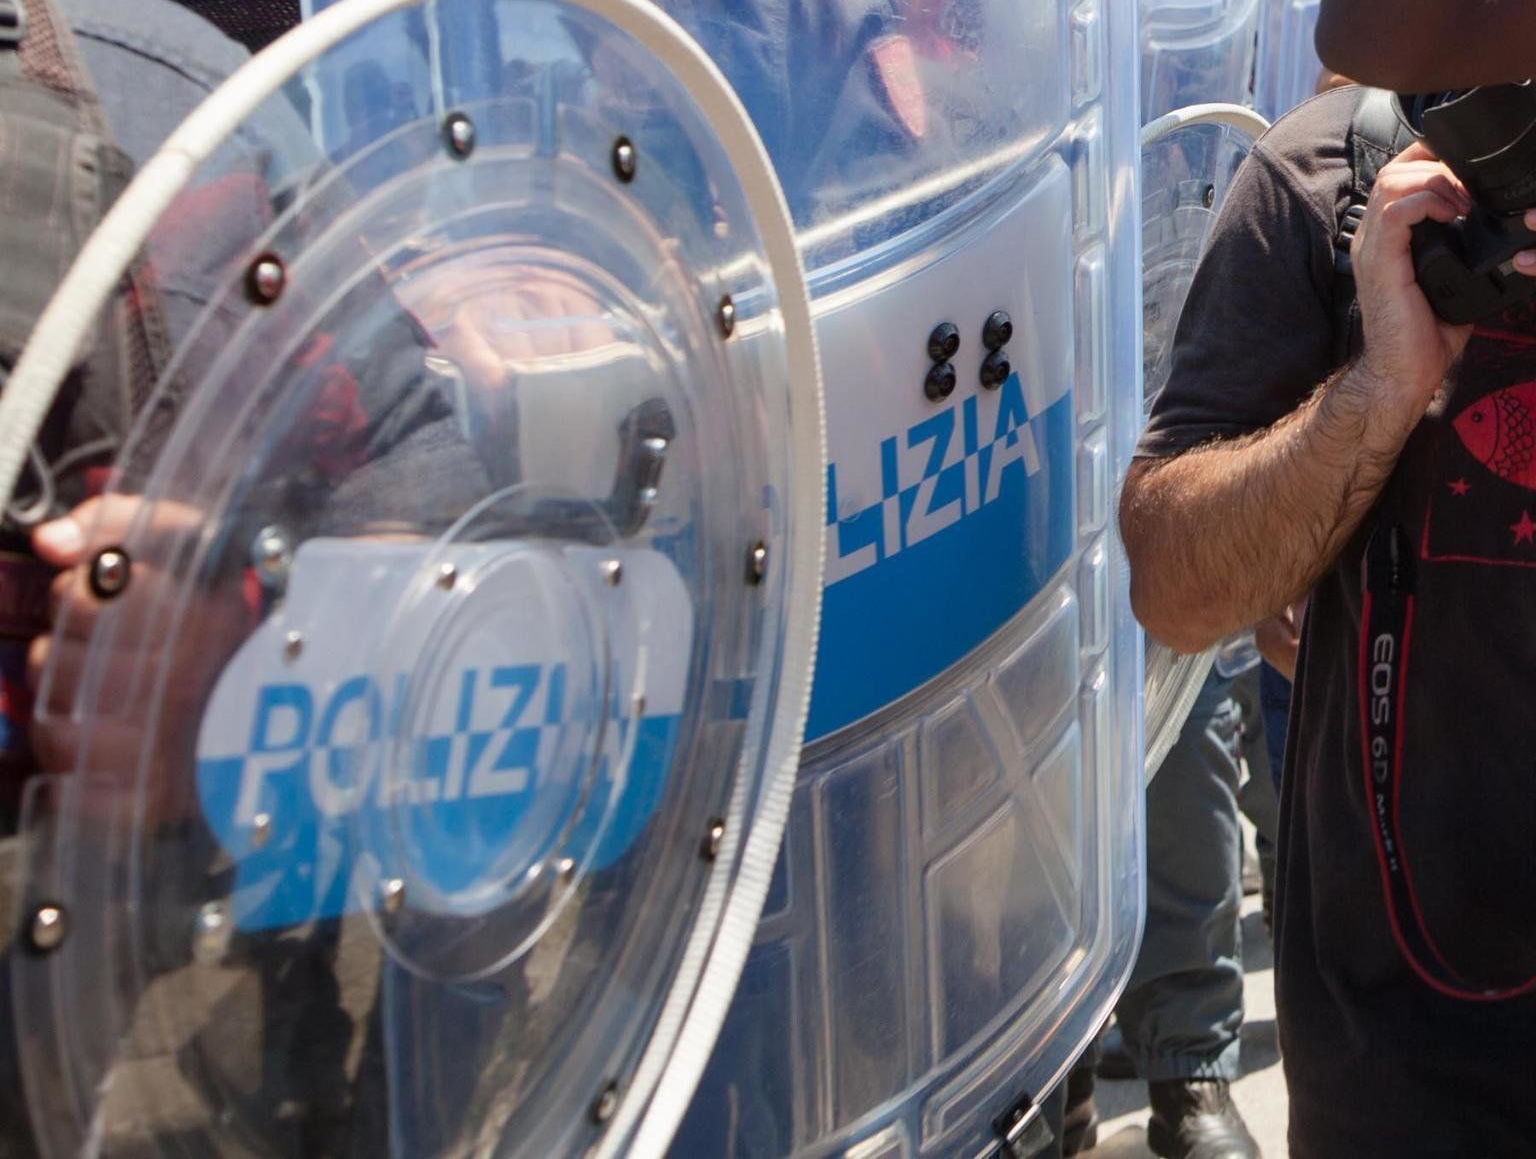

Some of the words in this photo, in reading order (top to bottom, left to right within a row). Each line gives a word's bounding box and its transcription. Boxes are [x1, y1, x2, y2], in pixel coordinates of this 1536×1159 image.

[825, 371, 1040, 588] LIZIA
[1372, 633, 1394, 725] EOS
[1372, 736, 1387, 783] 6D
